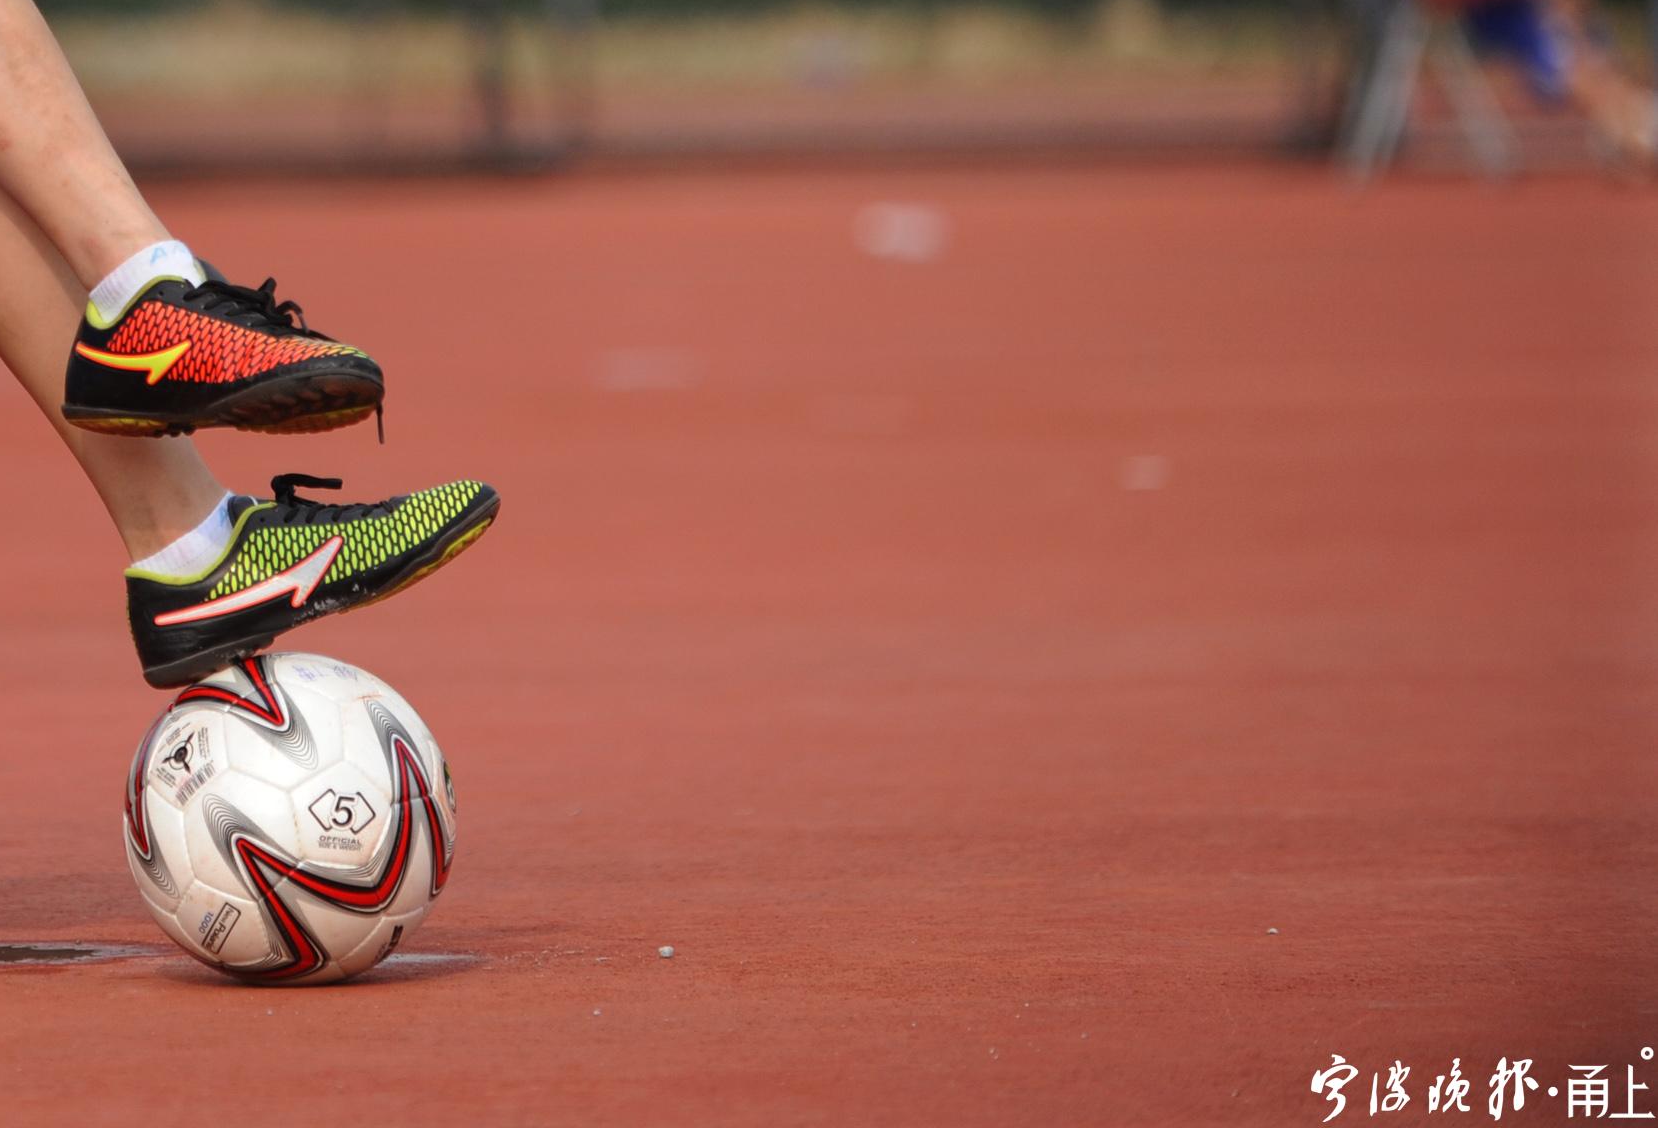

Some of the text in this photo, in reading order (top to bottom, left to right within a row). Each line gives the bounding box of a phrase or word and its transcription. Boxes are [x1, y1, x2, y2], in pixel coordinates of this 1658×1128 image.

[331, 796, 356, 827] 5
[319, 835, 361, 846] OFFICIAL
[198, 912, 214, 934] 1000
